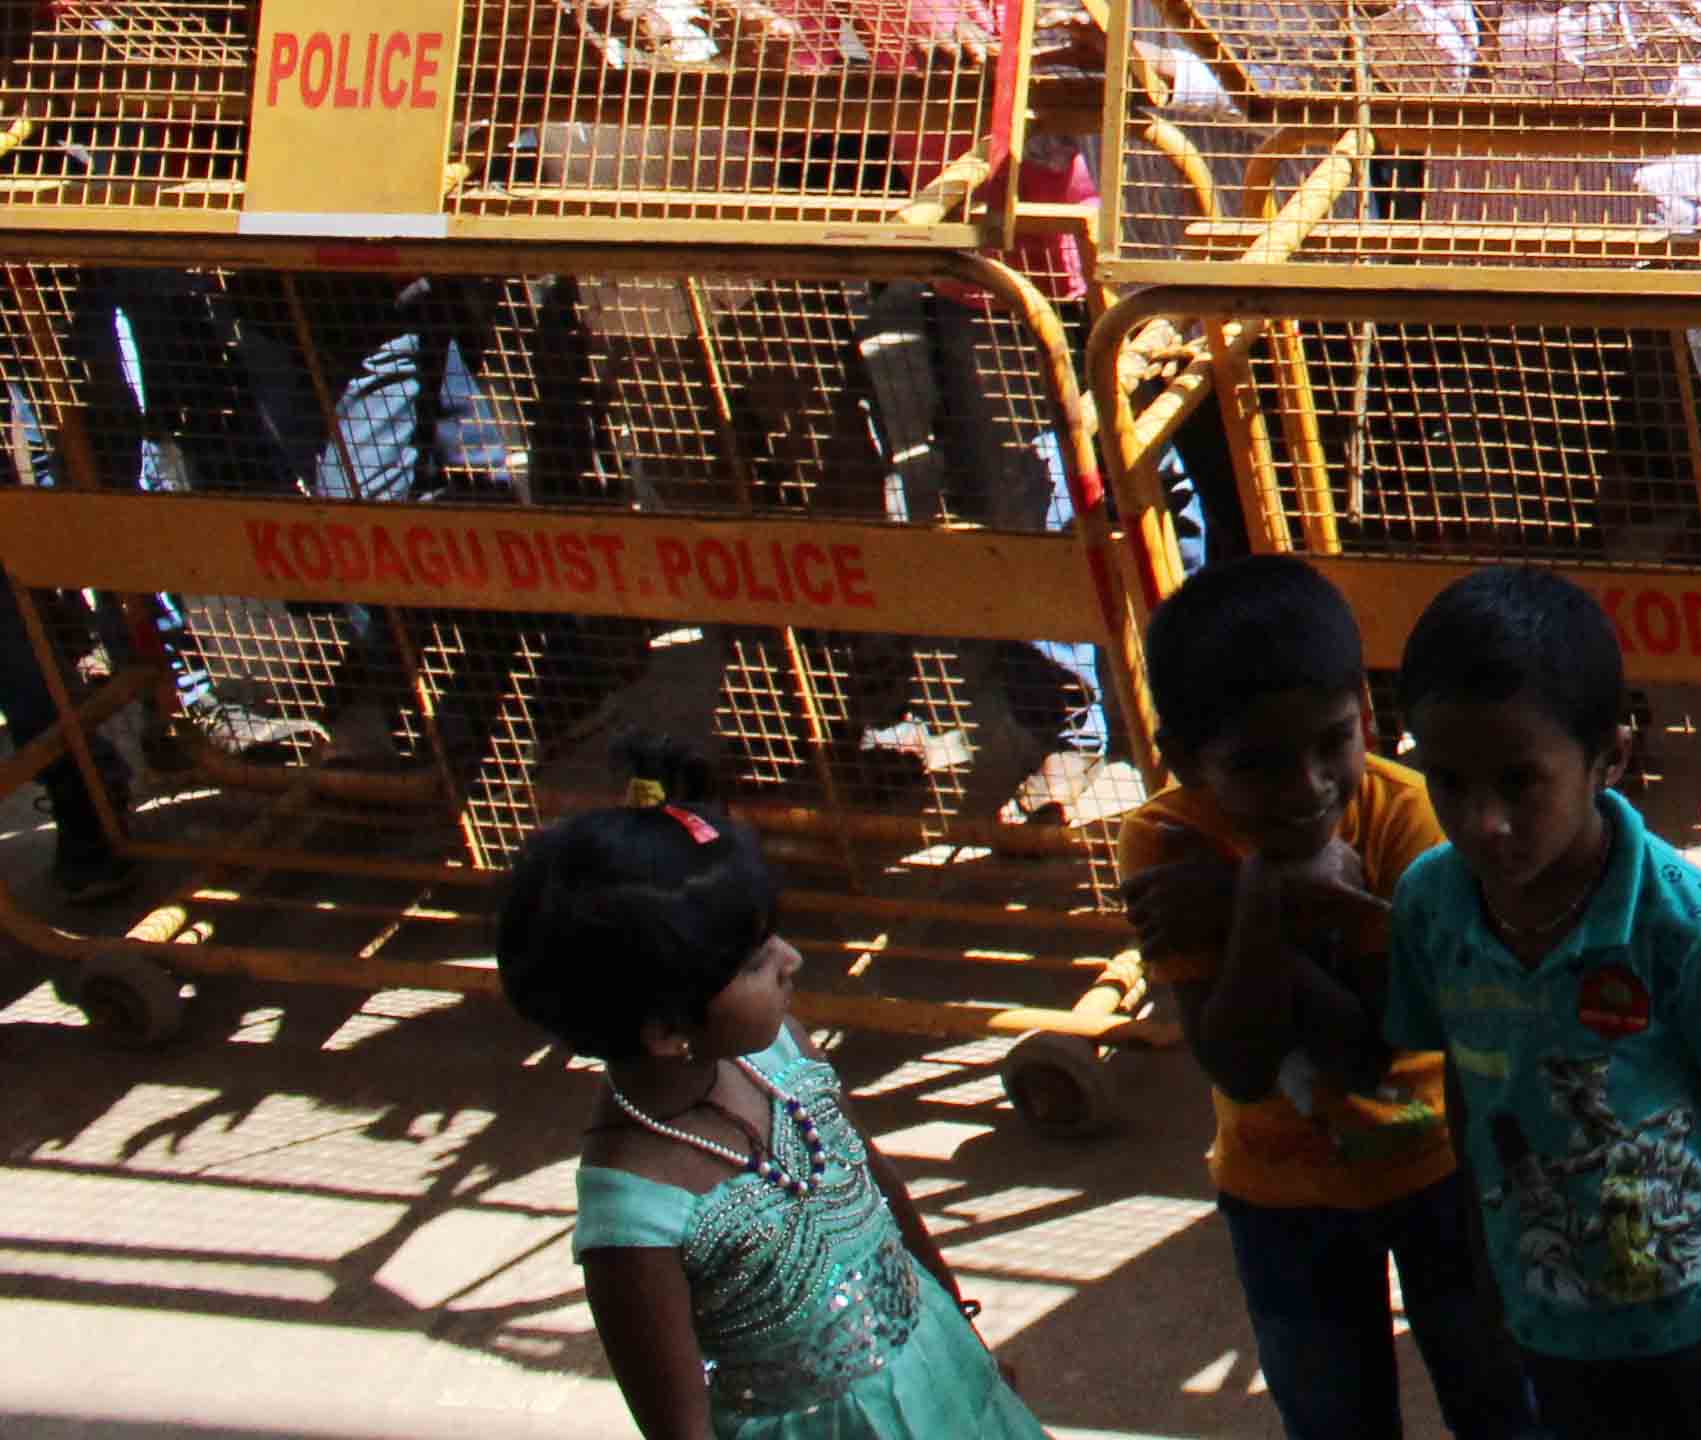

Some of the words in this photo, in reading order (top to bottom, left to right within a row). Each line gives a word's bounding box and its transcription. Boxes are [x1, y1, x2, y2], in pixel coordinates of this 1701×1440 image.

[266, 31, 444, 109] POLICE
[250, 519, 488, 588] KODAGU
[657, 538, 874, 605] POLICE
